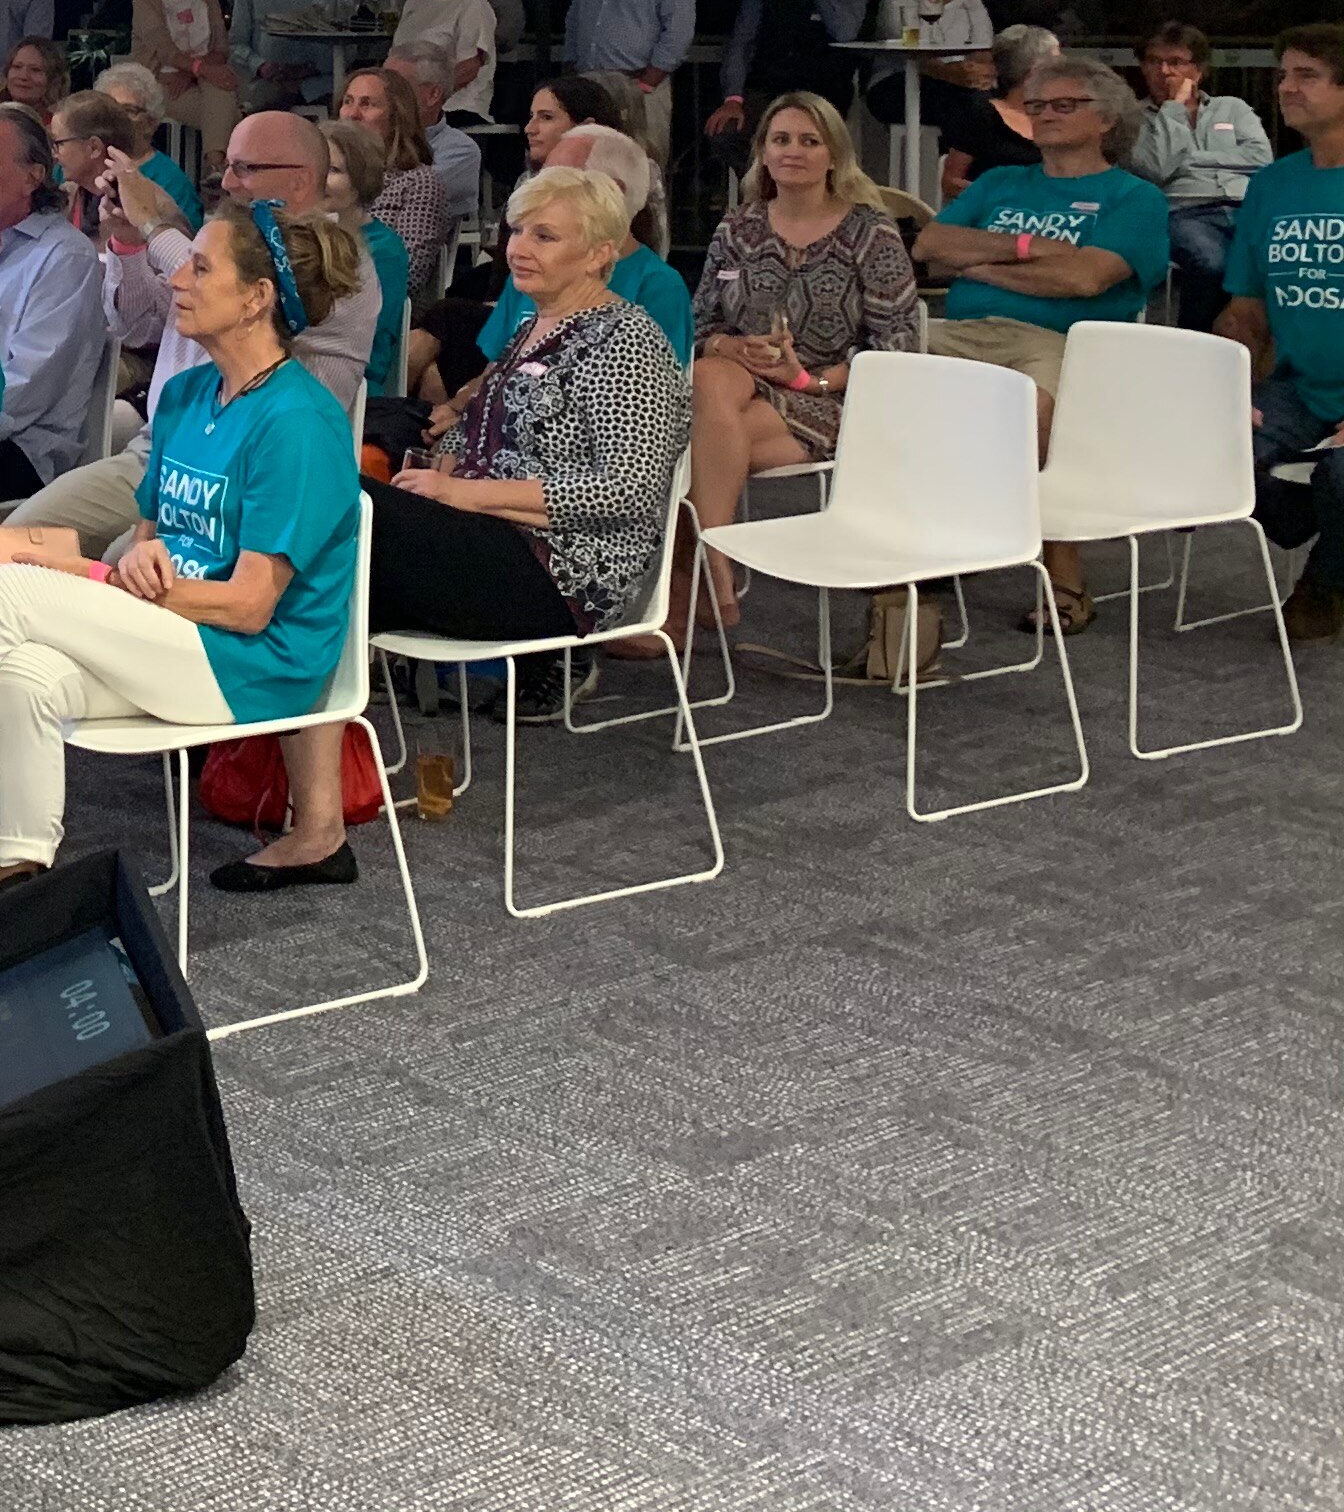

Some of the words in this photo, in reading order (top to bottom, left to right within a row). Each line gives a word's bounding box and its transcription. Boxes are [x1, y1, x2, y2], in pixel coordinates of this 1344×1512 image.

[994, 210, 1086, 229] SANDY
[1272, 219, 1344, 240] SAND
[1269, 243, 1344, 263] BOLTO
[1298, 267, 1326, 279] FOR
[159, 465, 220, 510] SANDY
[158, 502, 216, 542] OLTON
[61, 979, 111, 1041] 04:00
